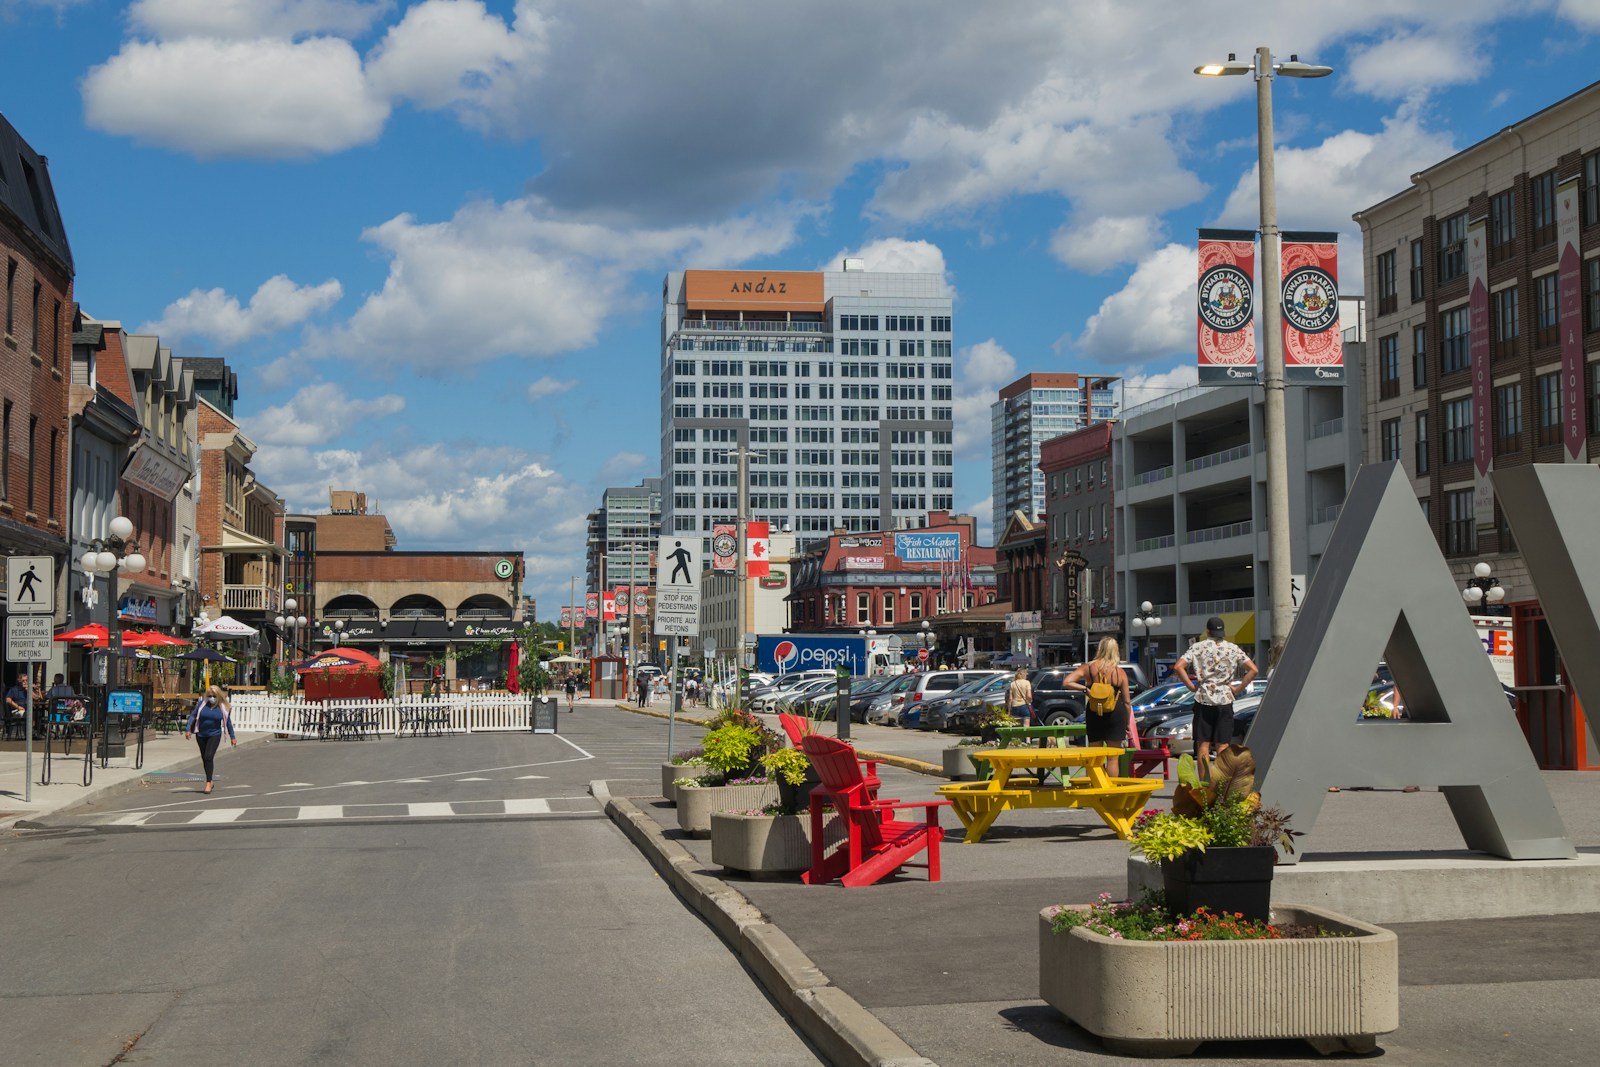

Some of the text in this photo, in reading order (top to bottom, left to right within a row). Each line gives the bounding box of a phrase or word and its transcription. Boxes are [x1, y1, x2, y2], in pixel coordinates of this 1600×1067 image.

[1199, 245, 1221, 259] BYWARD
[1202, 272, 1250, 299] BYWARD MARKET
[1286, 274, 1335, 300] BYWARD MARKET
[1205, 309, 1245, 326] MARCHÉ BY
[1289, 311, 1331, 327] MARCHÉ BY
[1290, 329, 1298, 348] BYW
[1245, 342, 1254, 353] BY
[1332, 342, 1341, 353] BY
[1227, 367, 1253, 378] Ottawa
[1315, 367, 1340, 378] Ottawa
[1569, 358, 1577, 437] LOUER
[898, 537, 922, 549] Fish
[923, 537, 957, 547] Market
[906, 547, 957, 559] RESTAURANT
[501, 564, 509, 573] P
[1068, 566, 1076, 620] HOUSE
[658, 602, 697, 610] PEDESTRIANS
[16, 619, 31, 627] STOP
[657, 615, 683, 623] PRIORITÉ
[11, 628, 49, 637] PEDESTRIANS
[10, 639, 49, 648] PRIORITÉ AUX
[1129, 640, 1139, 653] P
[800, 645, 850, 665] pepsi
[1157, 663, 1168, 677] P
